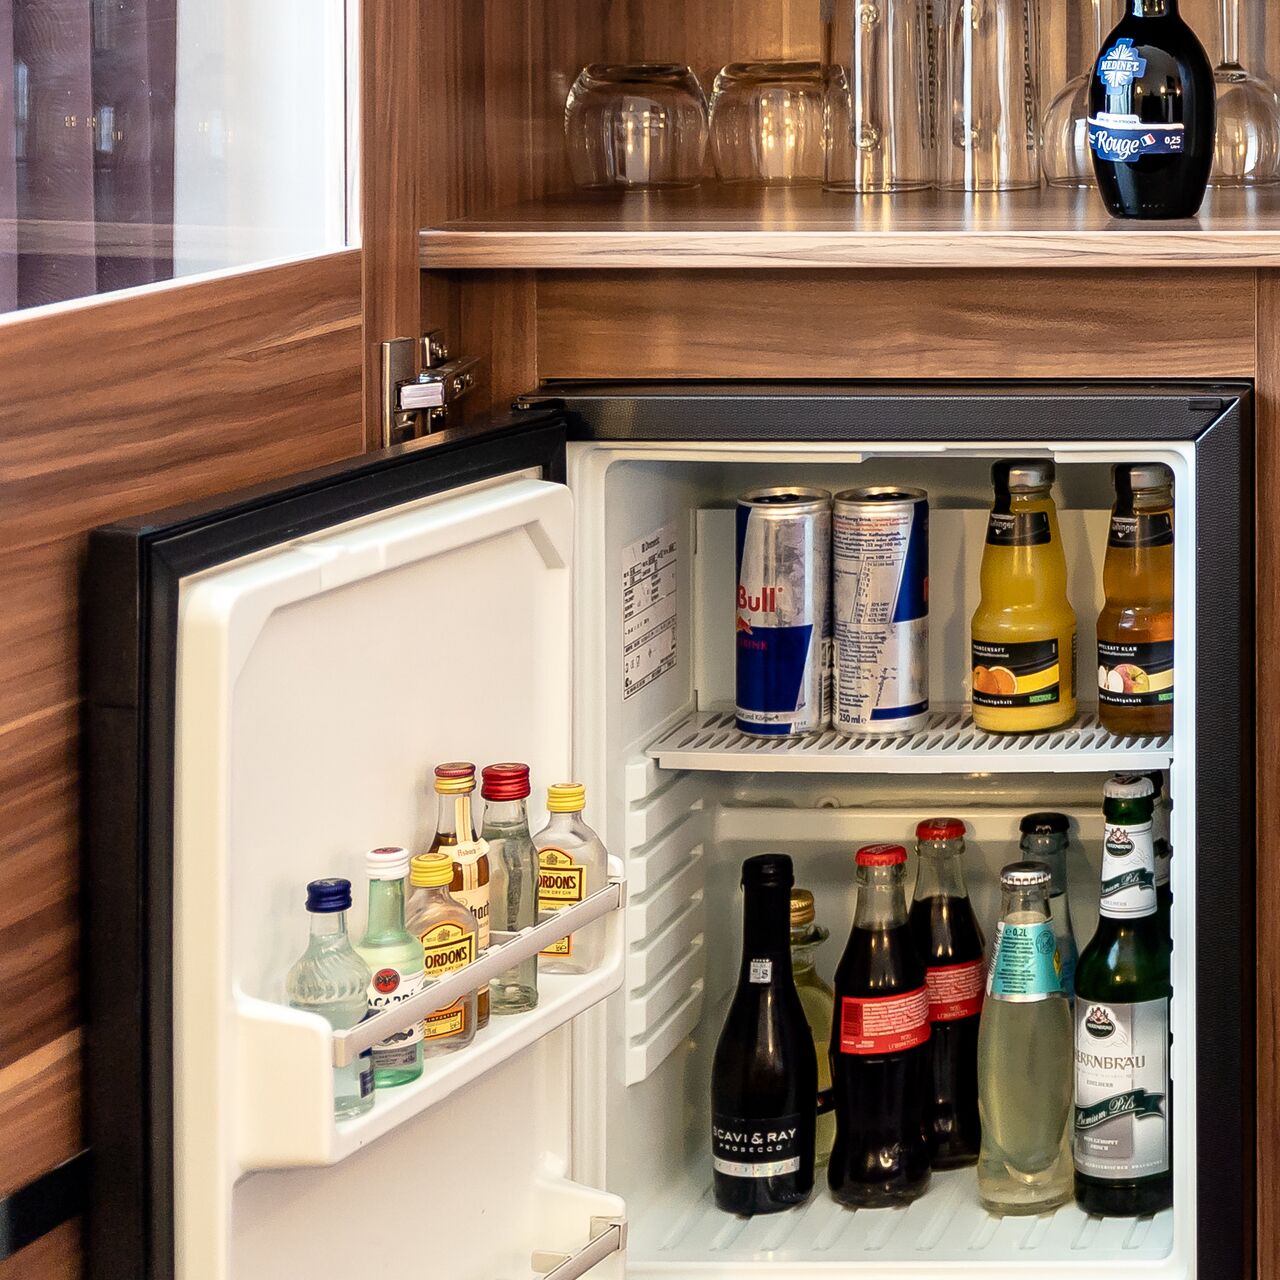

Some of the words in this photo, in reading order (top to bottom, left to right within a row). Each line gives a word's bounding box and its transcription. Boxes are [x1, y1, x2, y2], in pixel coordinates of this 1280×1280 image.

[1095, 130, 1140, 159] Rouge
[1164, 135, 1181, 145] 0,25
[737, 586, 776, 613] Bull
[851, 715, 860, 724] ml
[538, 874, 576, 889] ORDON'S
[1012, 927, 1028, 937] 0,2L
[425, 946, 467, 969] ORDON'S
[1077, 1050, 1145, 1070] ERRNBRÄU
[1108, 1095, 1136, 1114] Pils
[751, 1132, 763, 1144] &
[767, 1128, 797, 1142] RAY
[720, 1142, 782, 1153] PROSECCO
